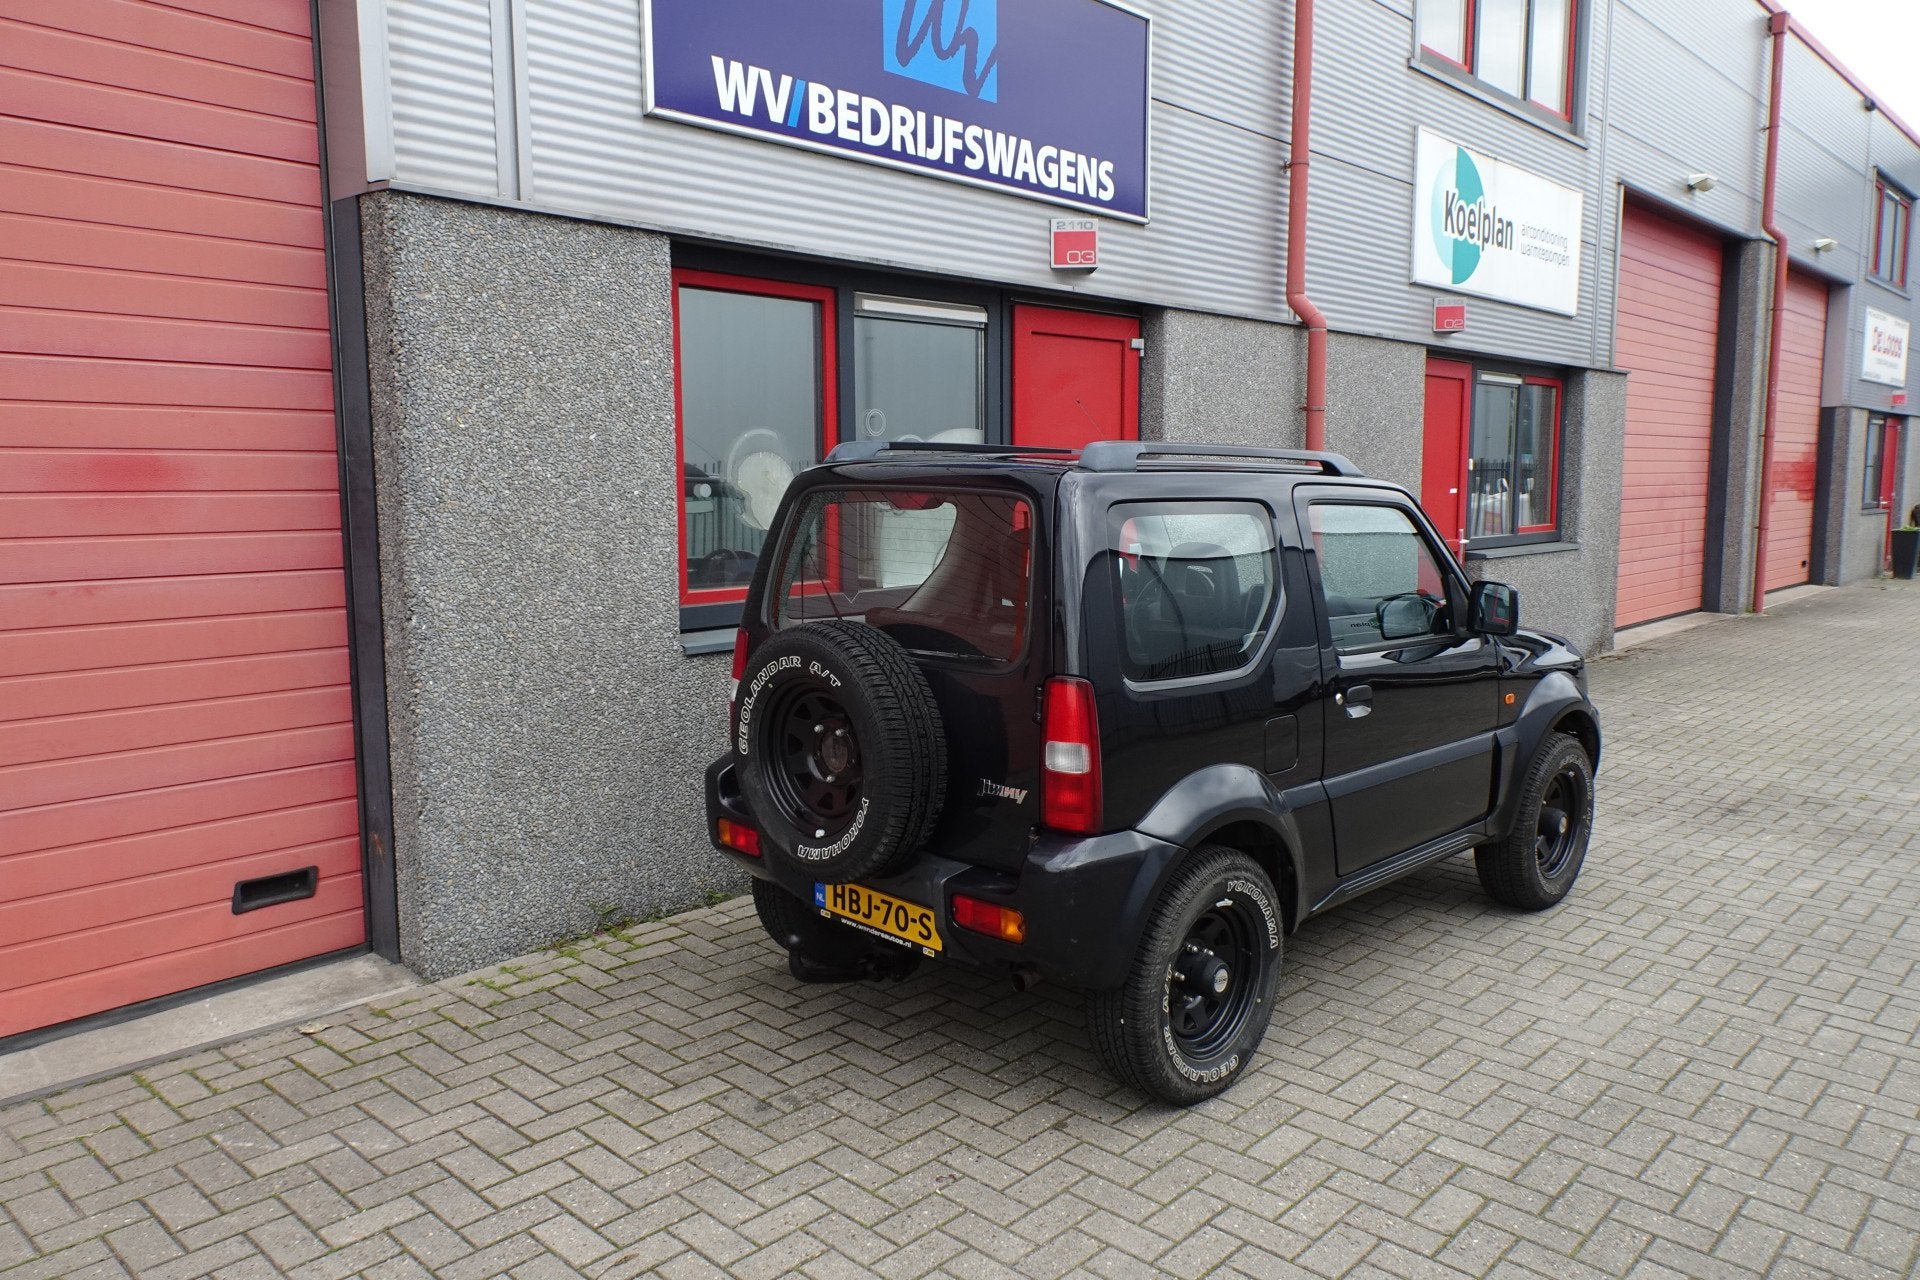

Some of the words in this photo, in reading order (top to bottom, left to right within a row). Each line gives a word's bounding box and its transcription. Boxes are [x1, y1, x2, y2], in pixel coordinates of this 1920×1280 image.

[1056, 221, 1094, 230] 2110
[1444, 190, 1513, 252] Koelplan
[1521, 223, 1568, 252] airconditioning
[1067, 250, 1095, 264] 03
[1520, 242, 1570, 269] warmtepompen
[738, 655, 802, 755] GEOLANDAR
[809, 660, 842, 687] A/T
[797, 796, 870, 861] YOKOHAMA
[815, 892, 825, 903] NL
[832, 884, 932, 941] HBJ-70-S
[1226, 880, 1279, 949] YOKOHAMA
[1163, 1024, 1239, 1082] GEOLANDAR
